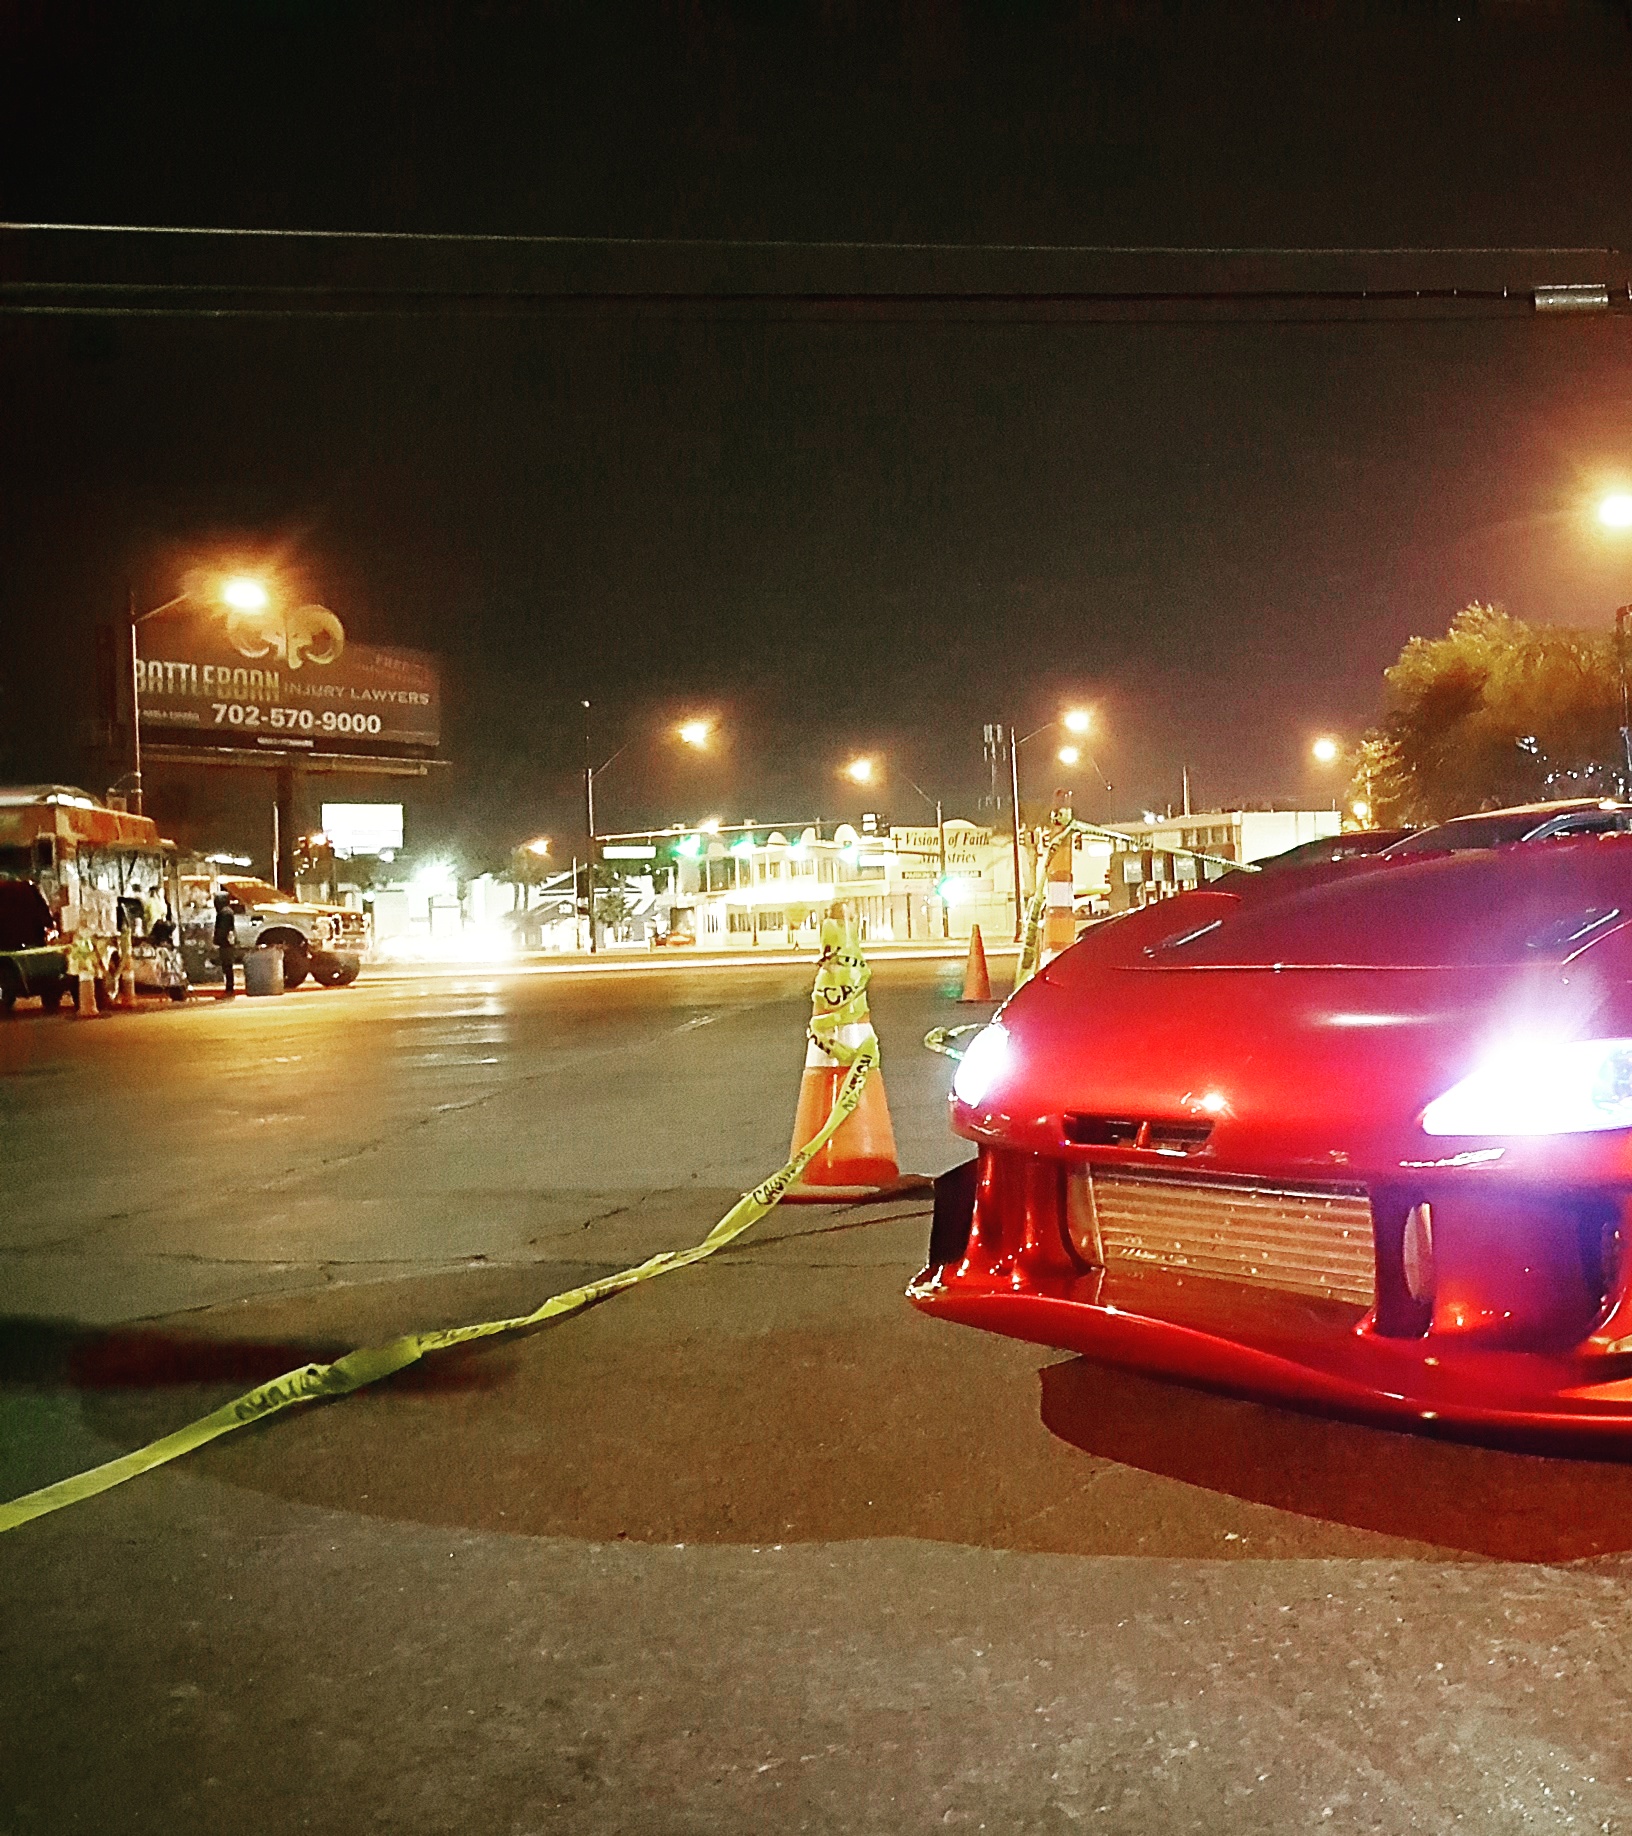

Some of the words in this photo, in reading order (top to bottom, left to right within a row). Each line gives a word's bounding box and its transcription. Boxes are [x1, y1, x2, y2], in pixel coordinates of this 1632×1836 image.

[284, 682, 345, 698] INJURY
[350, 687, 431, 706] LAWYERS
[211, 703, 382, 734] 702-570-9000
[905, 832, 939, 847] Vision
[948, 832, 960, 848] of
[962, 832, 990, 847] Faith
[919, 849, 977, 865] Minstries
